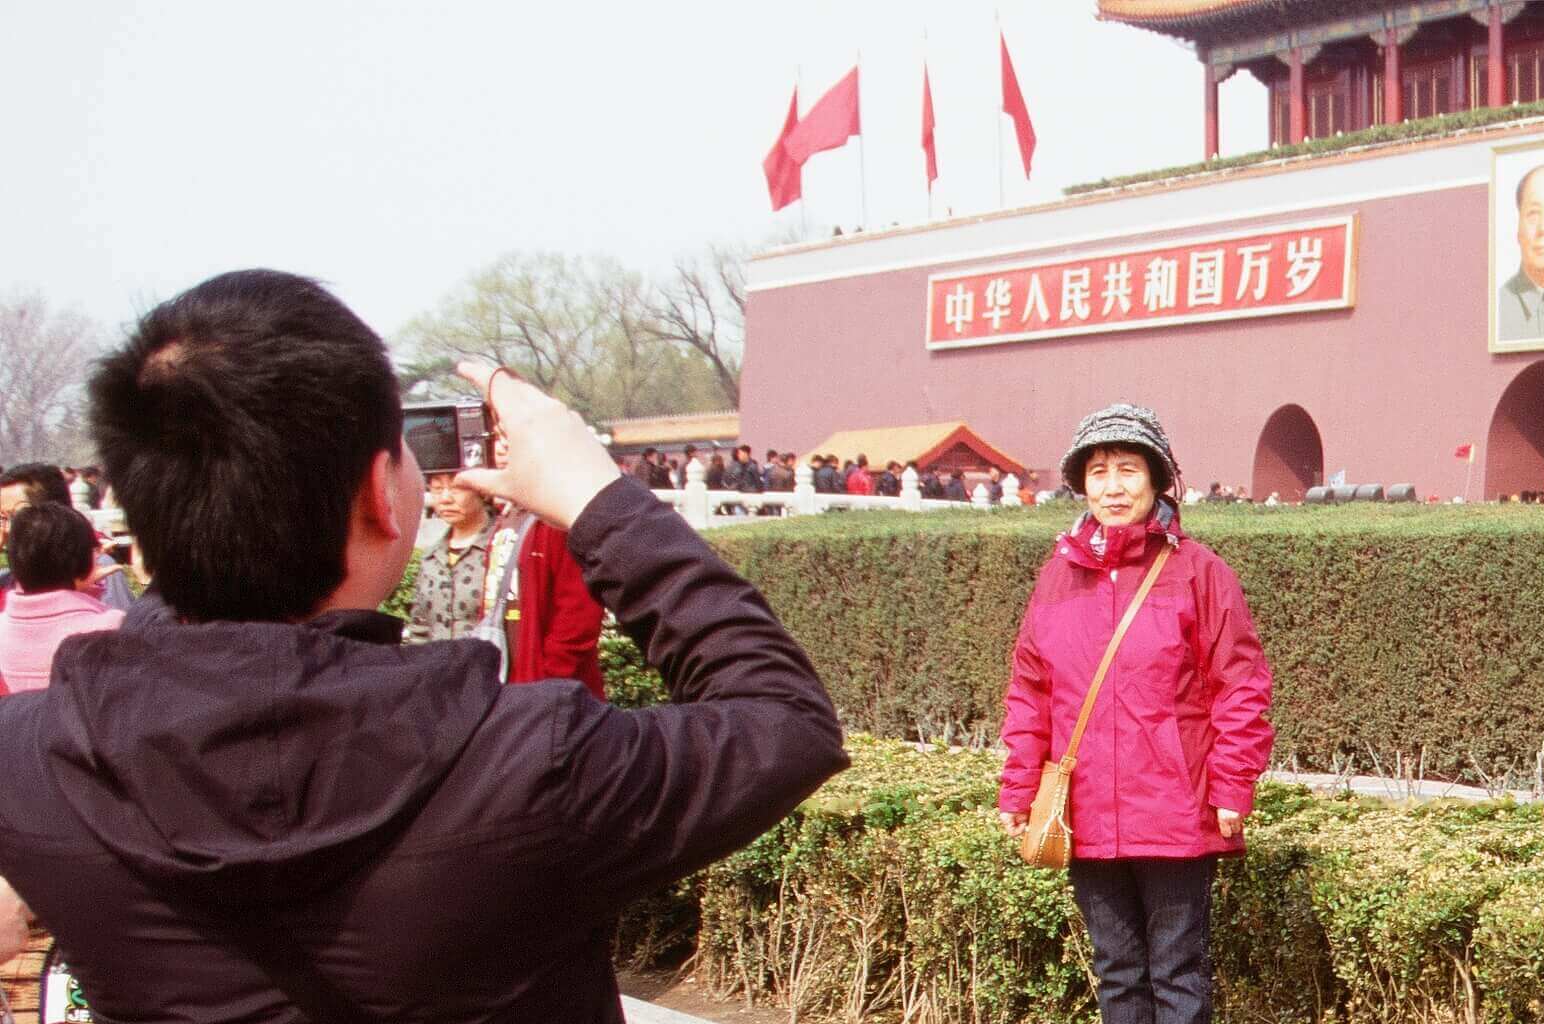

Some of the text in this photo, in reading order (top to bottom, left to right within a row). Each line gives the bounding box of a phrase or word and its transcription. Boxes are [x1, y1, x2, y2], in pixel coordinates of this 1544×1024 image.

[943, 235, 1324, 334] 中华人民共和国万岁
